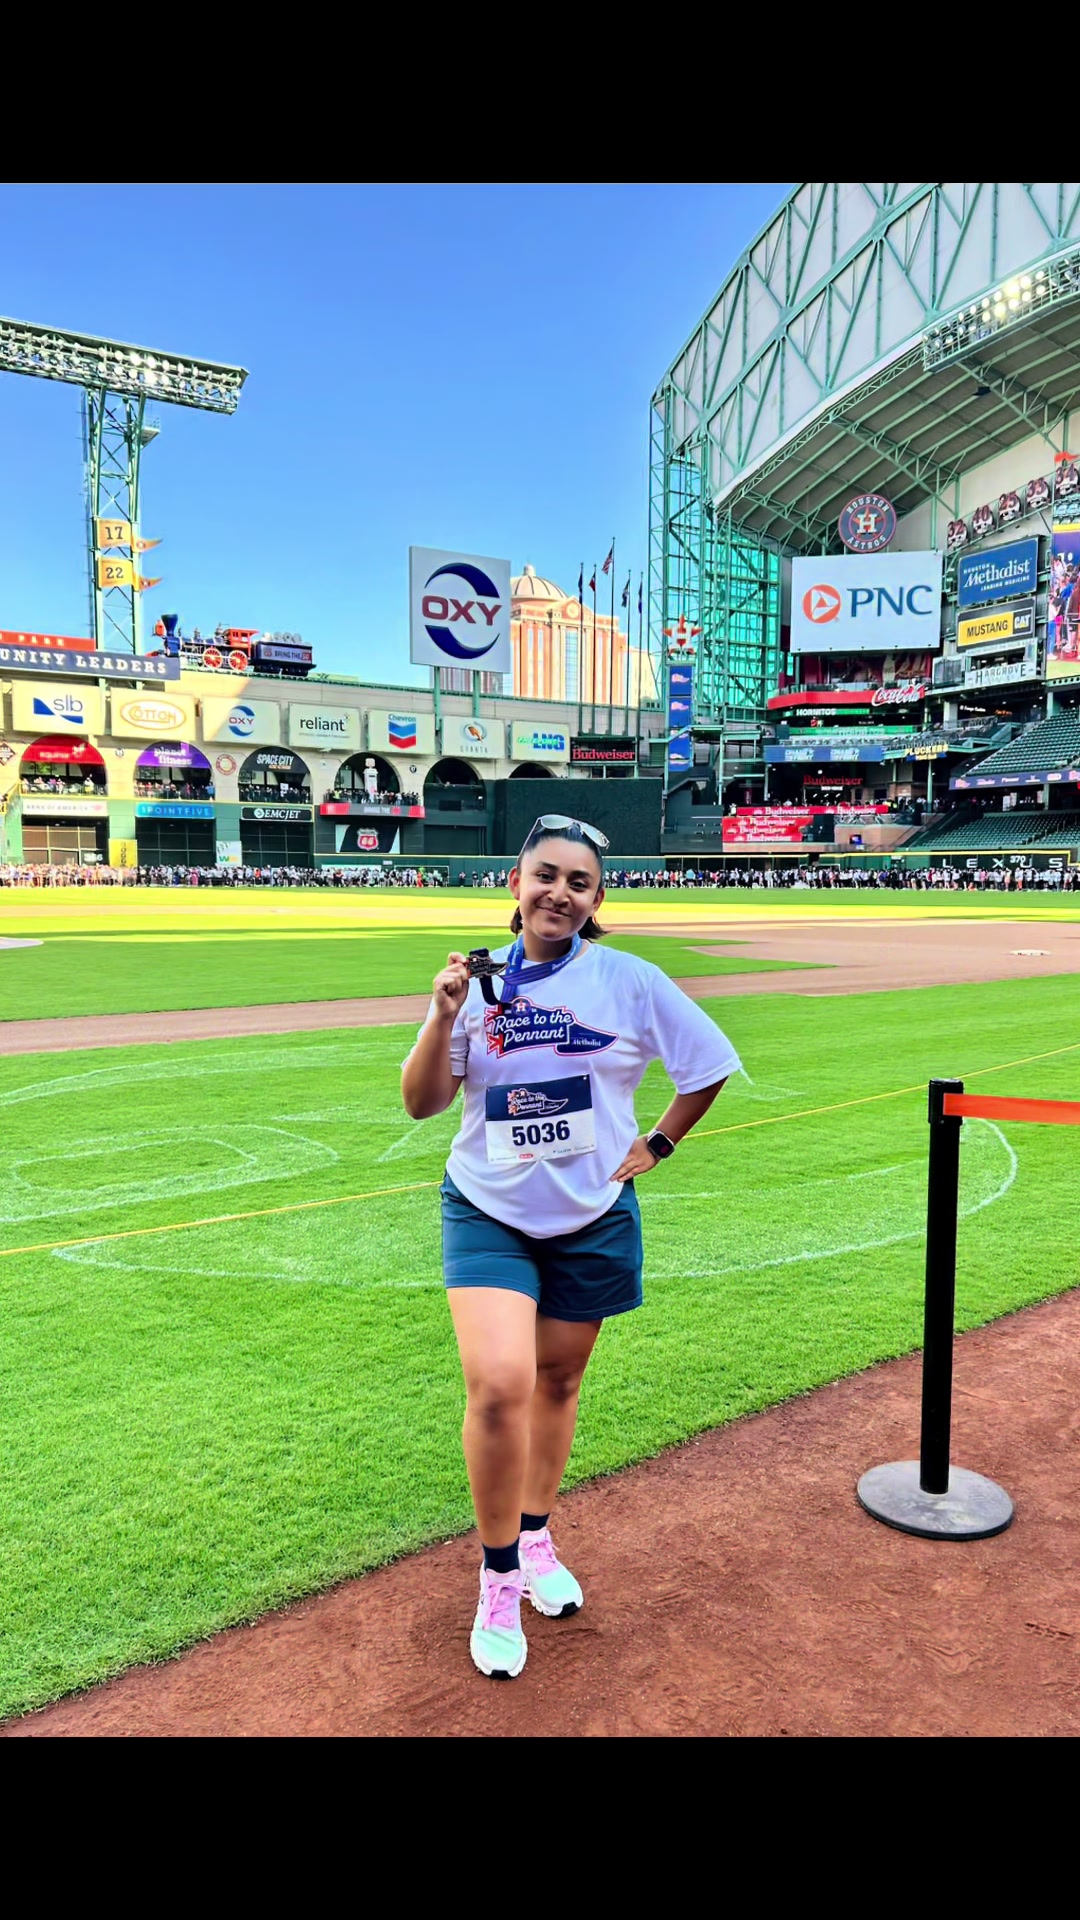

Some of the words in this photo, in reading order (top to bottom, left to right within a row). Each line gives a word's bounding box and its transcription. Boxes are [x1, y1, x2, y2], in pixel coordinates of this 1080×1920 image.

[846, 496, 890, 514] HOUSTON
[998, 490, 1017, 510] 25
[973, 505, 990, 523] 40
[105, 526, 123, 540] 17
[947, 518, 964, 537] 32
[847, 535, 886, 550] ASTROS
[105, 567, 124, 579] 22
[963, 559, 1031, 588] Methodist
[847, 584, 933, 618] PNC
[422, 595, 502, 626] OXY
[967, 620, 1009, 637] MUSTANG
[1014, 614, 1031, 629] CAT
[0, 648, 66, 666] UNITY
[76, 655, 167, 674] LEADERS
[975, 663, 1027, 686] HARGROVE
[53, 694, 83, 712] slb
[128, 705, 176, 724] COTTON
[228, 716, 255, 725] OXY
[388, 713, 416, 721] Chevron
[796, 708, 836, 717] HORNITOS
[299, 716, 346, 732] reliant
[533, 733, 564, 750] LNG
[572, 748, 635, 760] Budweiser
[902, 743, 949, 757] PLUCKERS
[256, 753, 279, 765] SPACE
[279, 755, 294, 766] CITY
[803, 775, 863, 786] Budweiser
[264, 808, 300, 820] EMCJET
[765, 807, 810, 815] Budweiser
[837, 805, 876, 815] Budweiser
[750, 816, 796, 825] Budweiser
[739, 825, 786, 834] Budweiser
[942, 857, 1063, 869] LEXUS
[1010, 855, 1026, 864] 370
[495, 1016, 531, 1034] Race
[534, 1013, 546, 1025] to
[549, 1010, 572, 1024] the
[503, 1028, 565, 1047] Pennant
[512, 1119, 570, 1146] 5036
